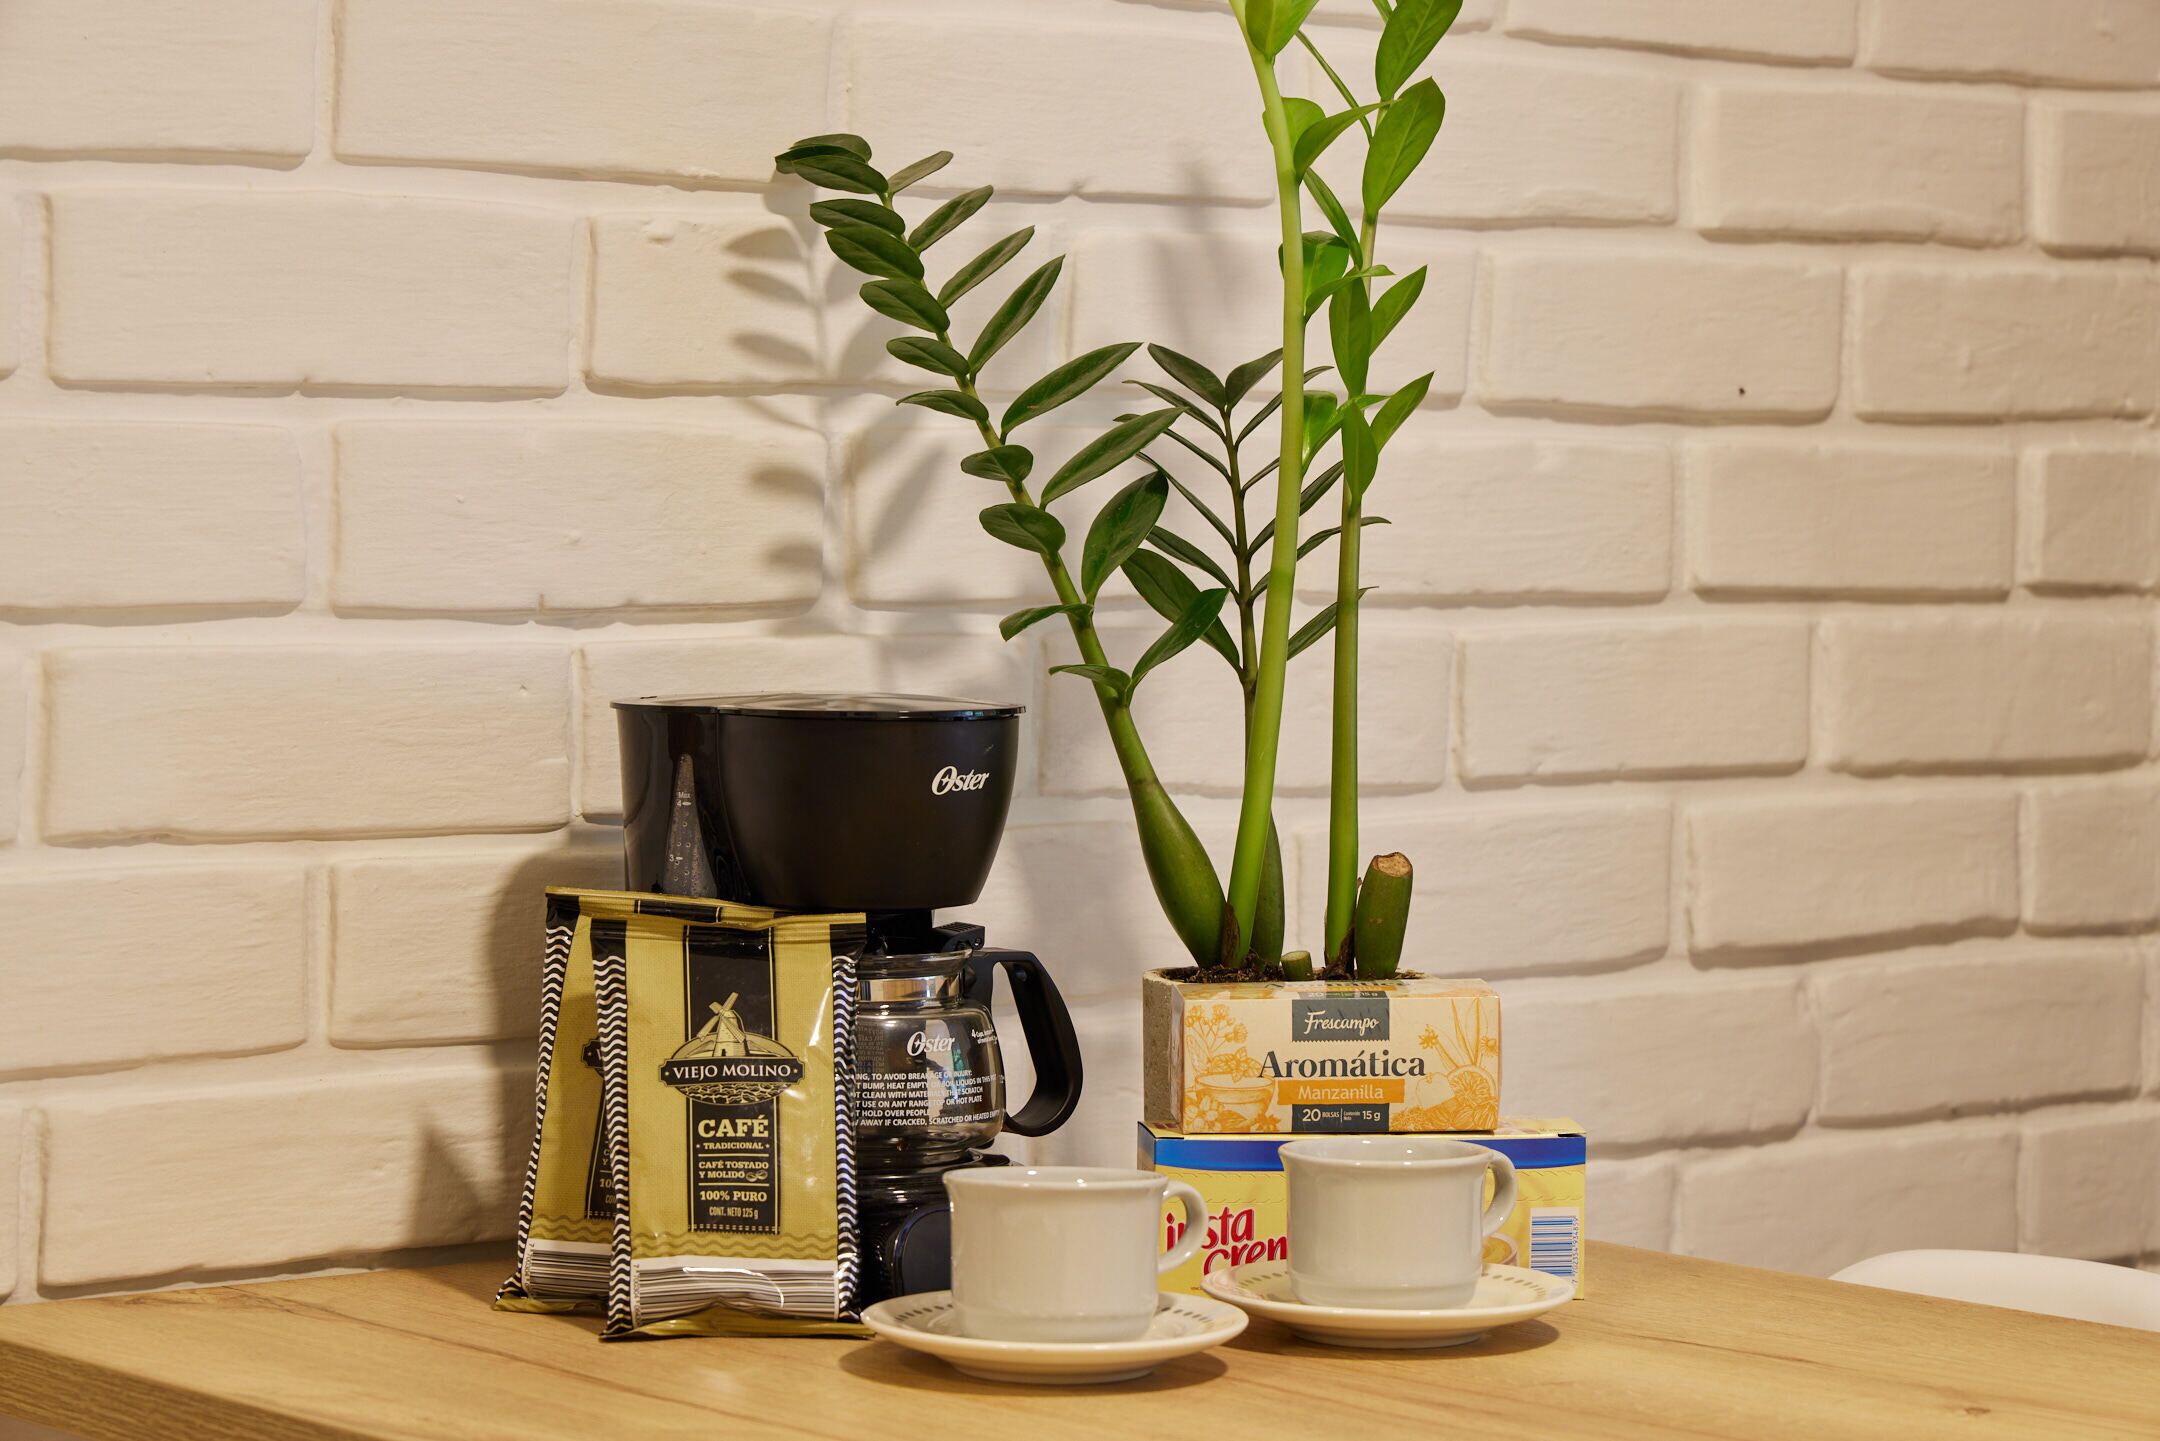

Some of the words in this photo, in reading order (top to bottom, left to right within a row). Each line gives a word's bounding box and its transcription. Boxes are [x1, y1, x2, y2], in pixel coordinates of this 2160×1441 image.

[931, 765, 990, 796] Oster
[678, 791, 691, 799] Max
[1303, 1010, 1380, 1037] Frescampo
[906, 1031, 956, 1057] Oster
[1257, 1049, 1427, 1079] Aromática
[672, 1064, 718, 1081] VIEJO
[722, 1063, 791, 1077] MOLINO
[883, 1072, 907, 1080] AVOID
[862, 1082, 885, 1090] BUMP,
[906, 1081, 929, 1089] EMPTY
[955, 1078, 977, 1087] LIQUIDS
[862, 1091, 887, 1099] CLEAN
[1298, 1084, 1385, 1100] Manzanilla
[862, 1100, 877, 1108] USE
[968, 1095, 983, 1103] PLATE
[862, 1109, 883, 1117] HOLD
[884, 1109, 905, 1117] OVER
[1302, 1108, 1321, 1122] 20
[1362, 1110, 1373, 1120] 15
[1373, 1111, 1381, 1122] g
[928, 1115, 964, 1125] SCRATCHED
[964, 1114, 973, 1122] OR
[698, 1114, 769, 1138] CAFÉ
[703, 1142, 764, 1150] TRADICIONAL
[698, 1160, 724, 1169] CAFÉ
[725, 1161, 769, 1169] TOSTADO
[698, 1170, 706, 1179] Y
[707, 1170, 746, 1179] MOLIDO
[600, 1178, 615, 1188] 10
[699, 1190, 730, 1201] 100%
[732, 1190, 768, 1202] PURO
[709, 1206, 726, 1216] CONT.
[727, 1207, 742, 1217] NETO
[742, 1207, 754, 1218] 125
[754, 1209, 759, 1220] g
[1166, 1206, 1255, 1252] ista
